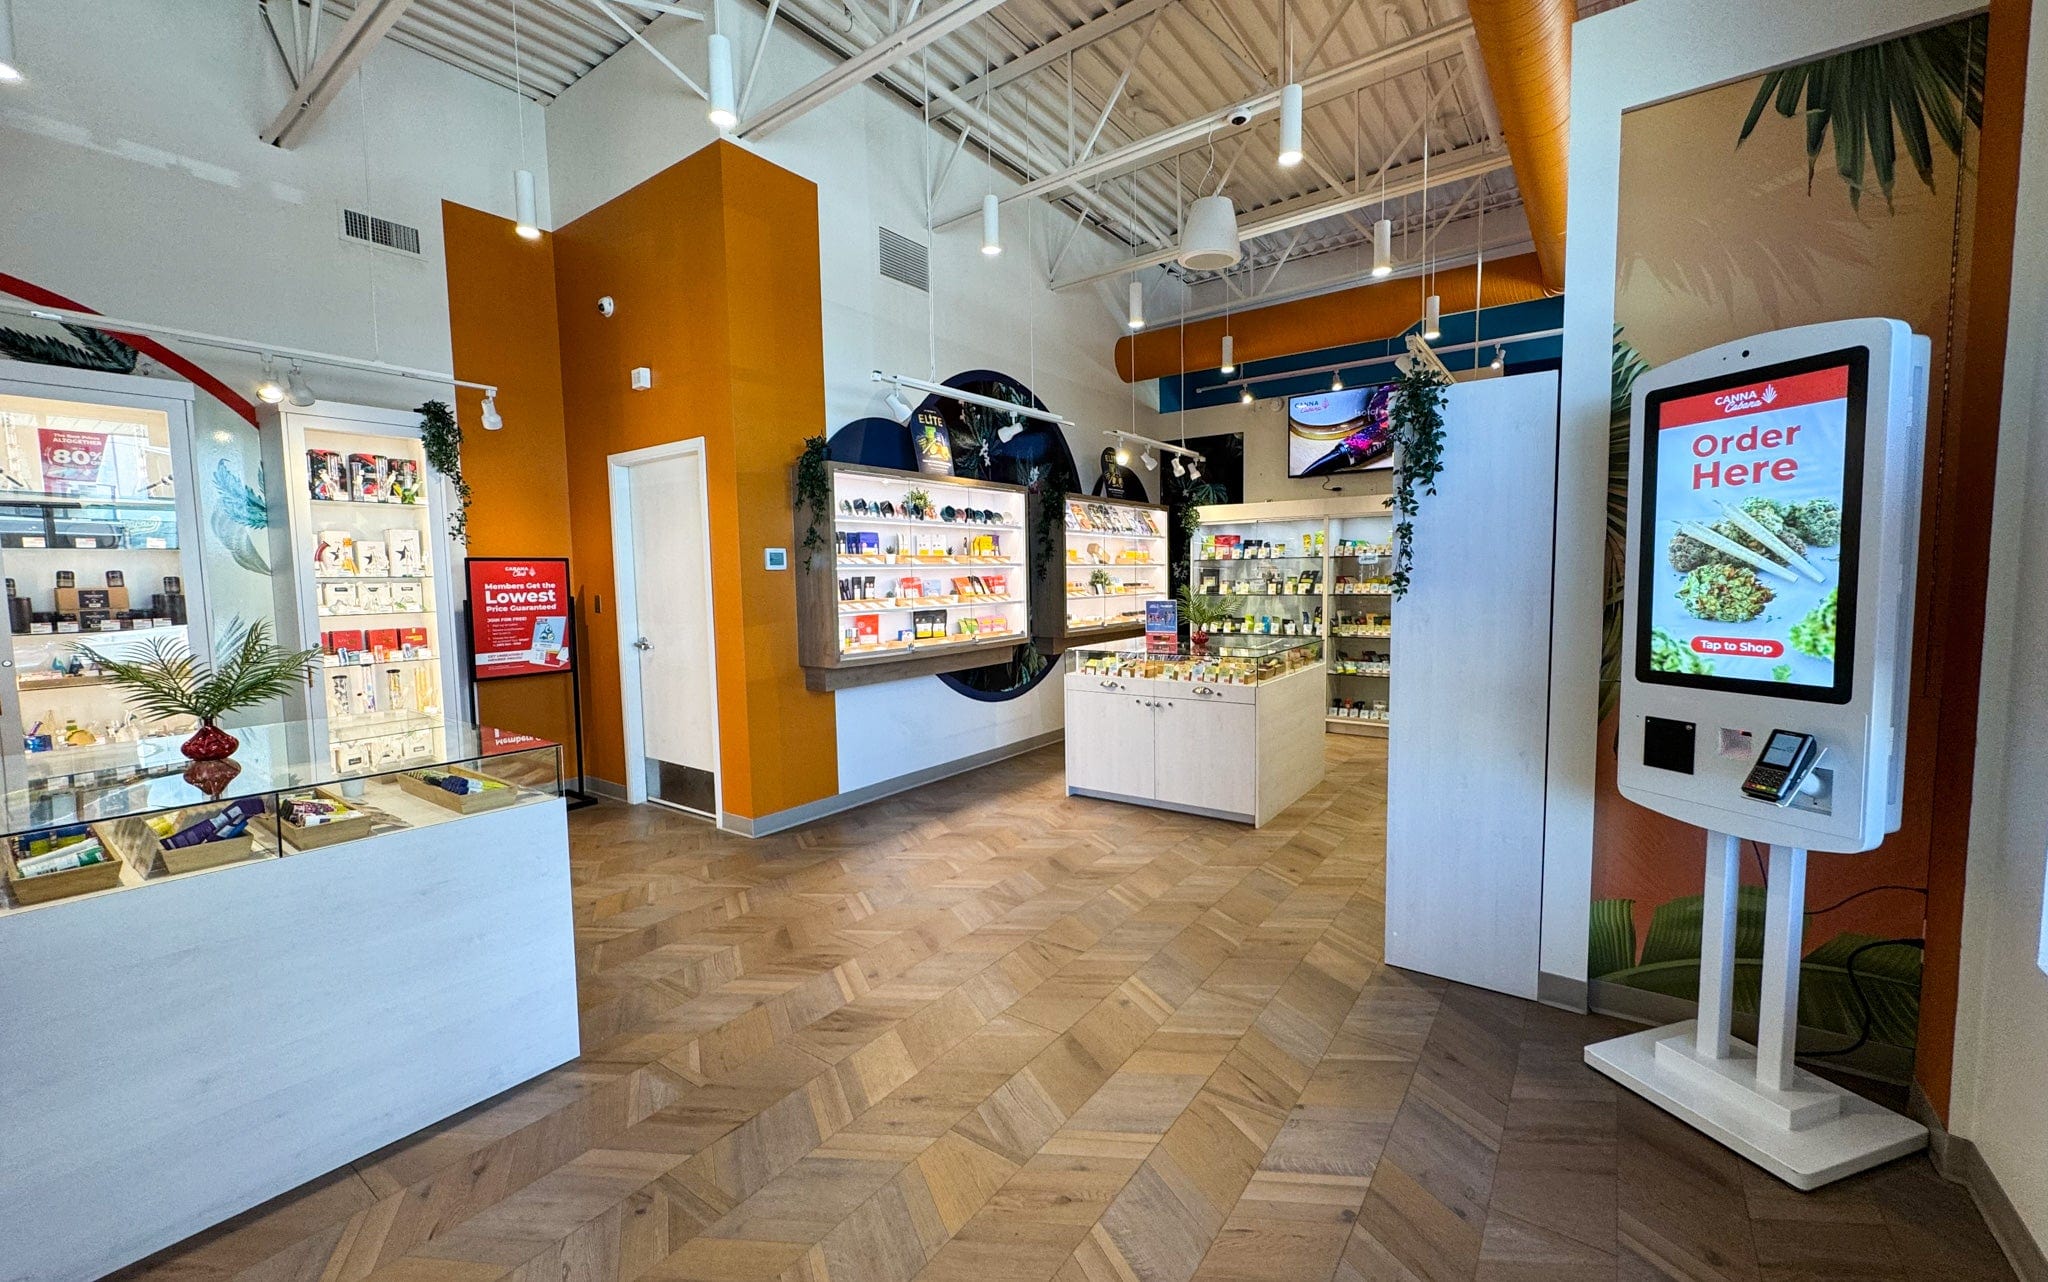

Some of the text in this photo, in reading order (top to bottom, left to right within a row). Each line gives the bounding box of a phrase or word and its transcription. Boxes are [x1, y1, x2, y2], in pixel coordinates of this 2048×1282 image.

[1715, 390, 1757, 406] CANNA
[1724, 400, 1762, 413] Cabana
[918, 413, 943, 427] ELITE
[53, 437, 102, 446] ALTOGETHER
[1692, 425, 1801, 458] Order
[52, 449, 104, 465] 80%
[1692, 458, 1798, 490] Here
[485, 589, 556, 604] Lowest
[510, 604, 556, 612] Guaranteed
[1700, 640, 1773, 655] Tap to Shop
